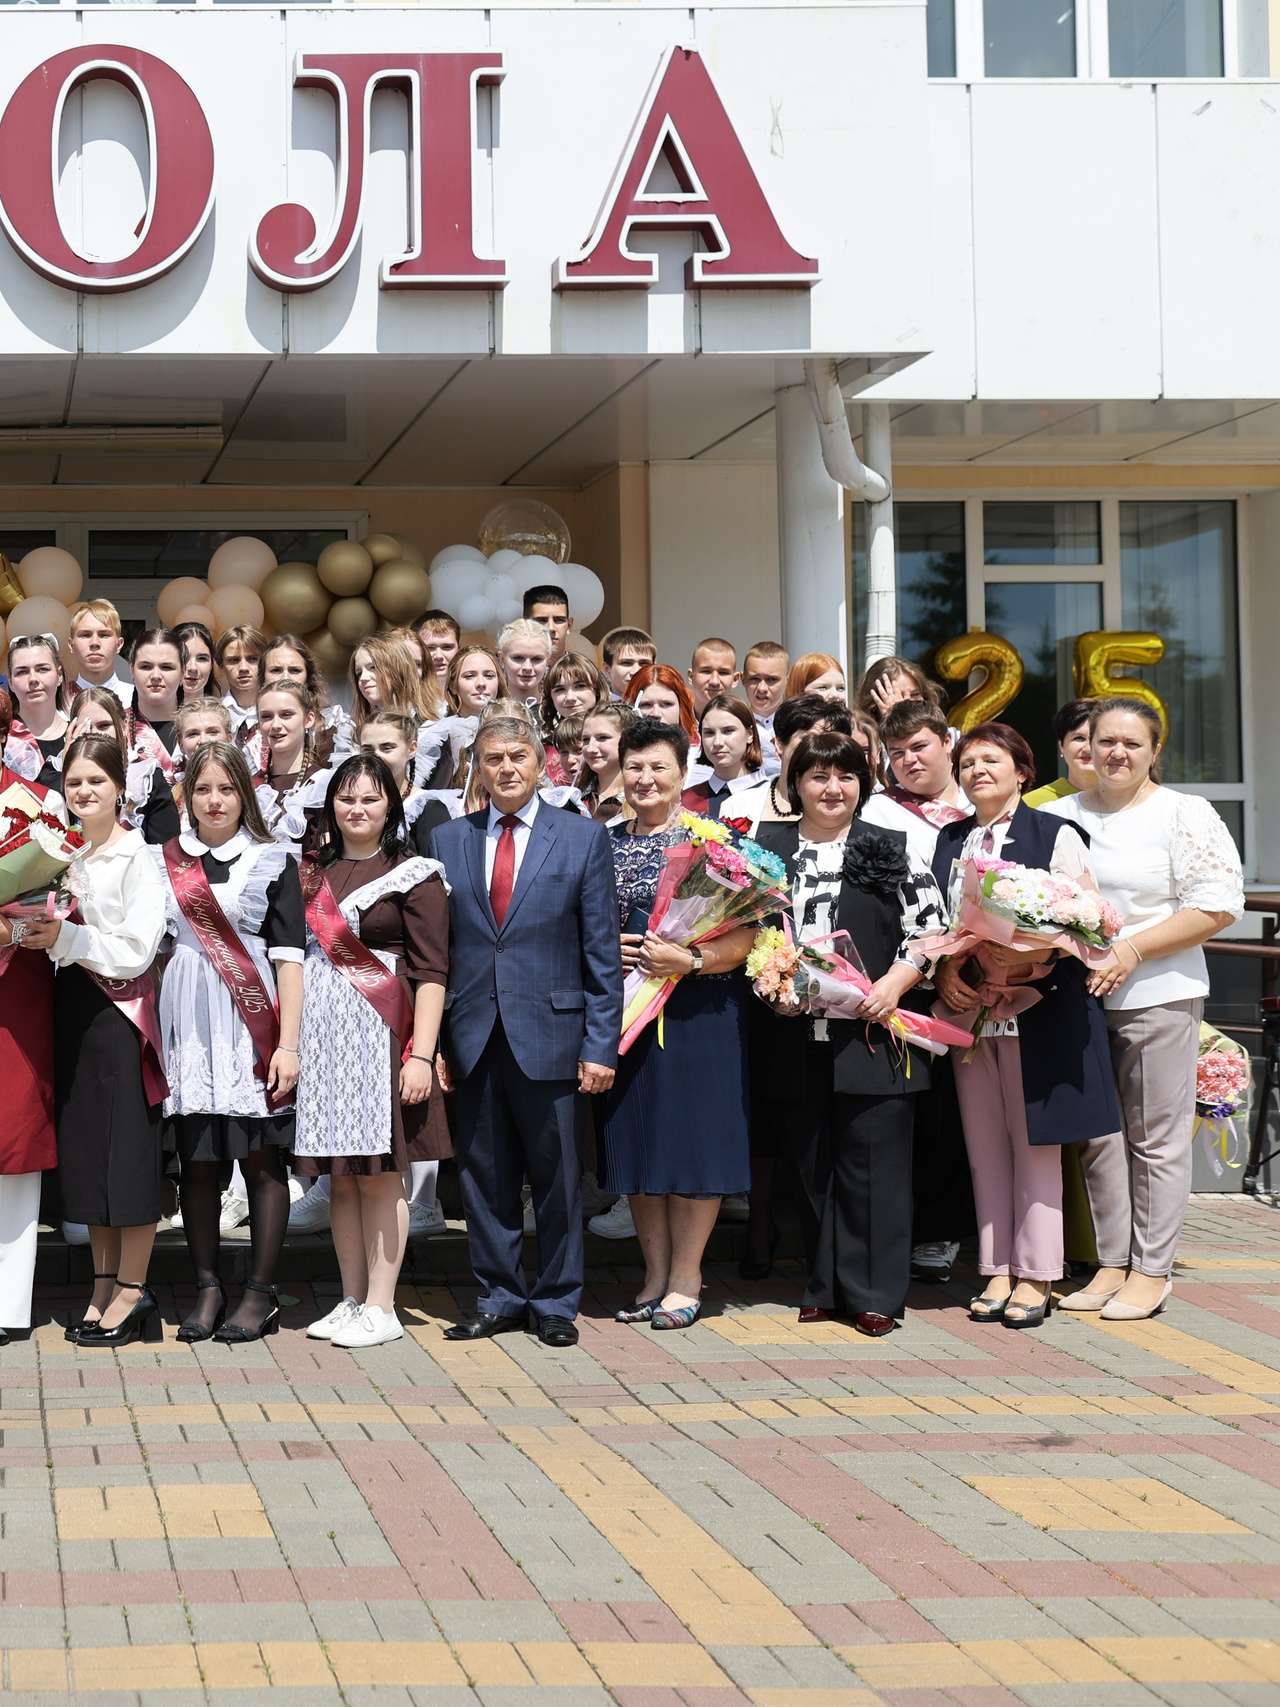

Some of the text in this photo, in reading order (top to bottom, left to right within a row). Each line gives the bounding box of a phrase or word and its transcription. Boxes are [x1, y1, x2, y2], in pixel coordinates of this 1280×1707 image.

[180, 880, 269, 1014] Выпускница 2025
[348, 960, 389, 988] 2025
